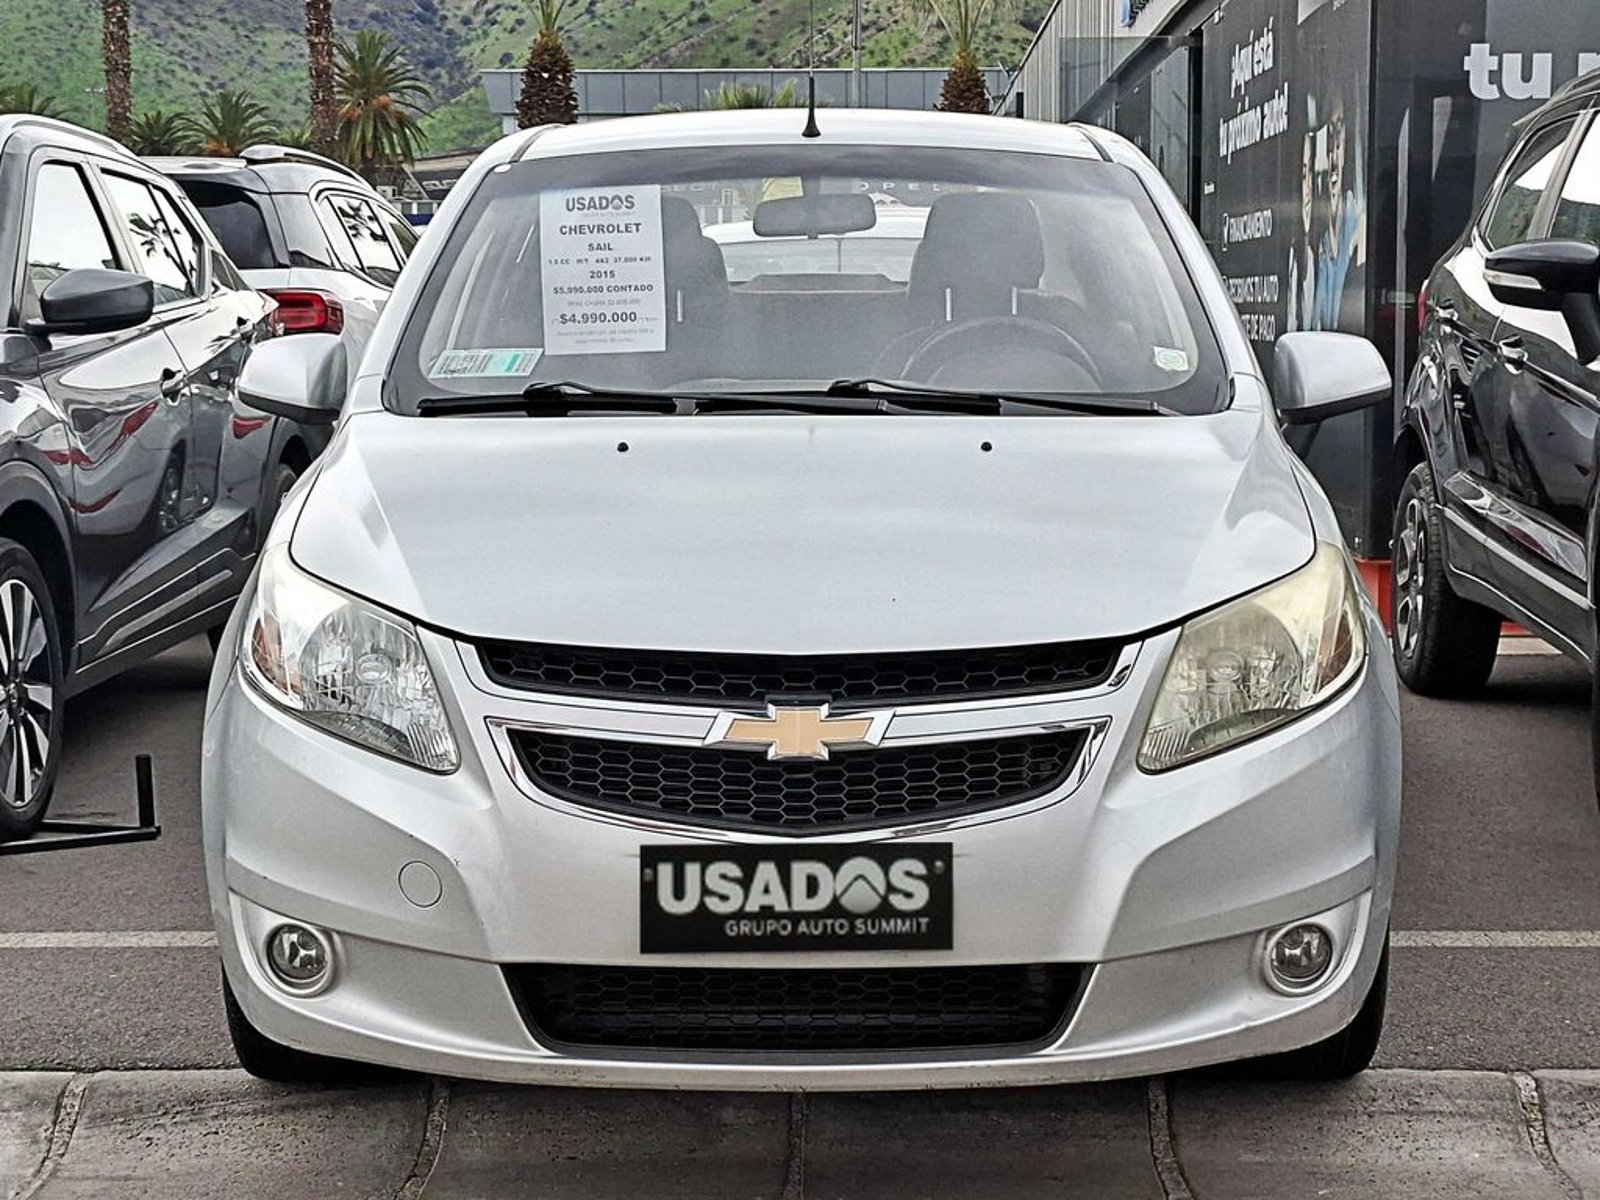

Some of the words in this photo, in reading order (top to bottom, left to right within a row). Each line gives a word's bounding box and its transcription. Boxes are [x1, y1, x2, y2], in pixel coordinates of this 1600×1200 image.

[1253, 16, 1274, 76] está
[1464, 43, 1552, 100] tu
[1227, 95, 1262, 165] próximo
[1263, 81, 1288, 139] auto!
[565, 194, 636, 212] USADOS
[559, 222, 643, 236] CHEVROLET
[588, 243, 614, 251] SAIL
[589, 270, 616, 279] 2015
[606, 284, 654, 293] CONTADO
[559, 311, 637, 325] $4.990.000
[657, 856, 930, 915] USADOS
[725, 919, 792, 937] GRUPO
[796, 918, 850, 934] AUTO
[854, 916, 930, 933] SUMMIT
